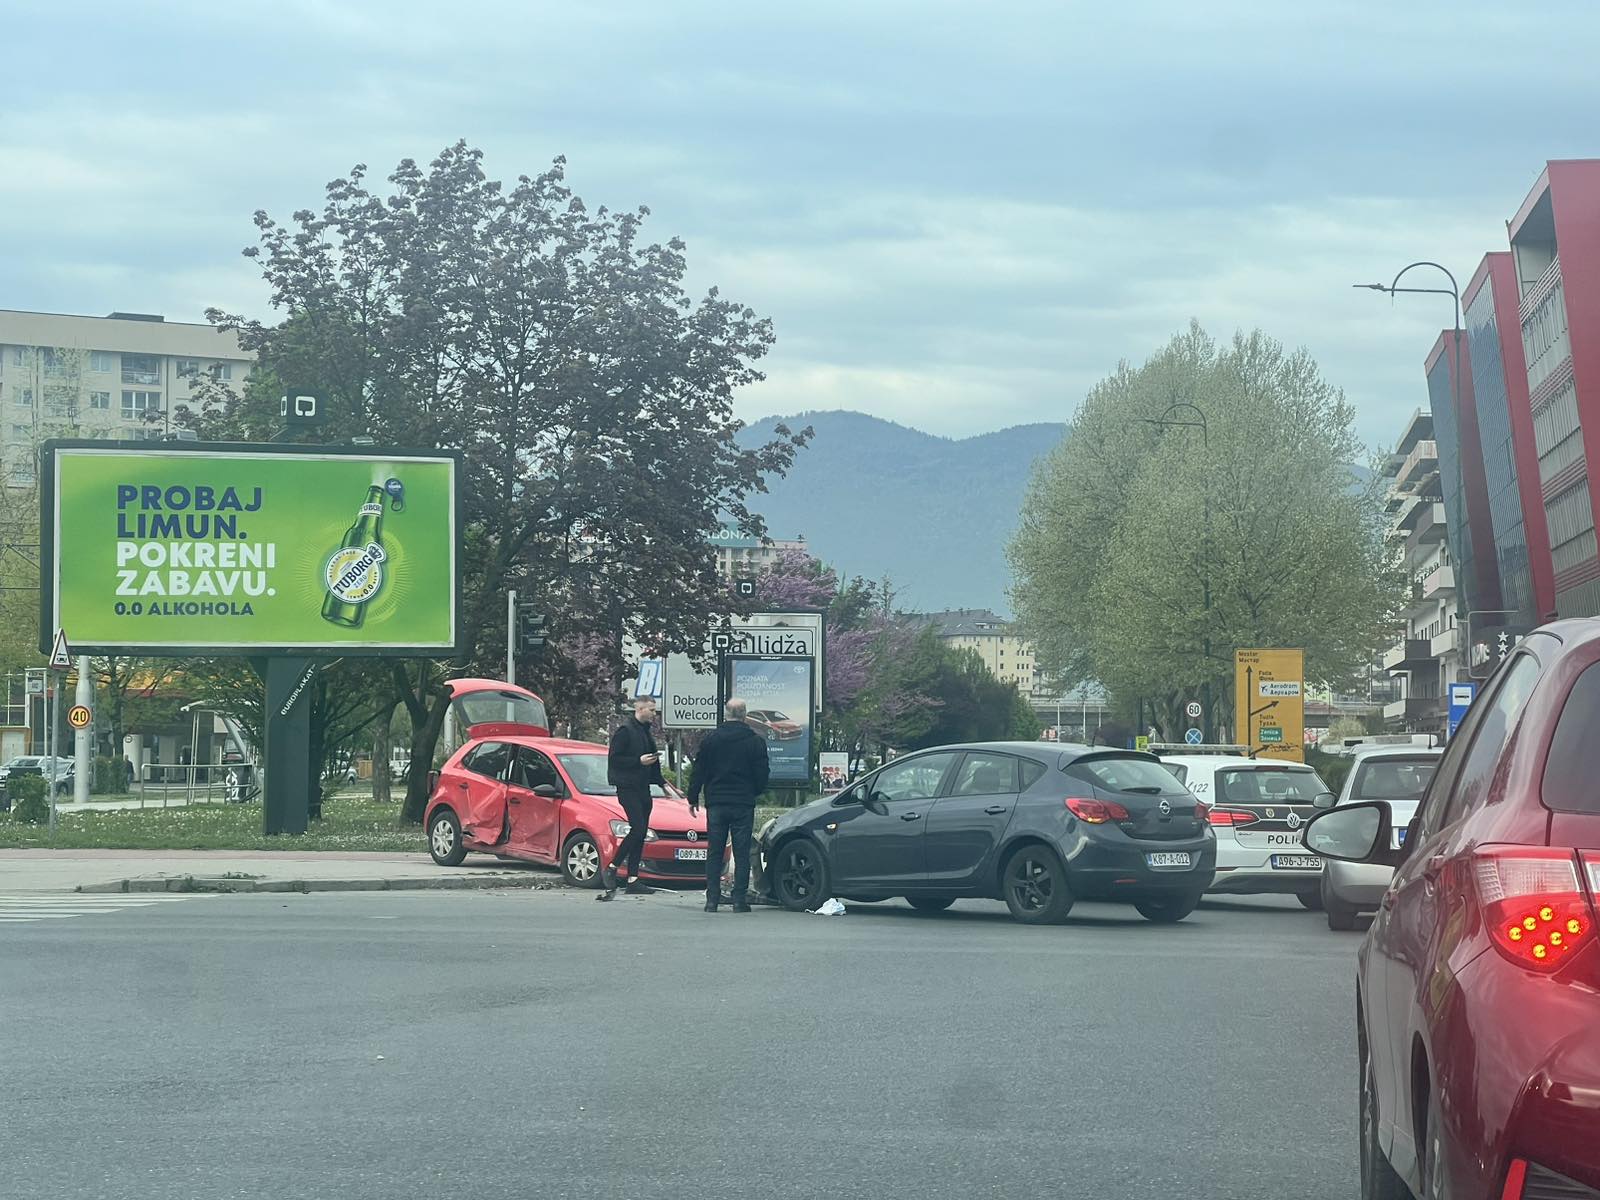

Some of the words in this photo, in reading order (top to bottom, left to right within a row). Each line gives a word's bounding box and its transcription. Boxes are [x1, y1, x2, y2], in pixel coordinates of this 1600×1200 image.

[117, 485, 262, 512] PROBAJ
[117, 513, 247, 539] LIMUN.
[117, 541, 275, 568] POKRENI
[333, 551, 375, 594] TUBORG
[353, 574, 368, 588] ZERO
[115, 570, 277, 596] ZABAVU.
[114, 602, 143, 615] 0.0
[147, 602, 254, 616] ALKOHOLA
[752, 633, 807, 654] Ilidža
[72, 711, 87, 722] 40
[1189, 705, 1200, 714] 60
[1193, 783, 1208, 793] 122
[1278, 857, 1320, 867] A96-J-755
